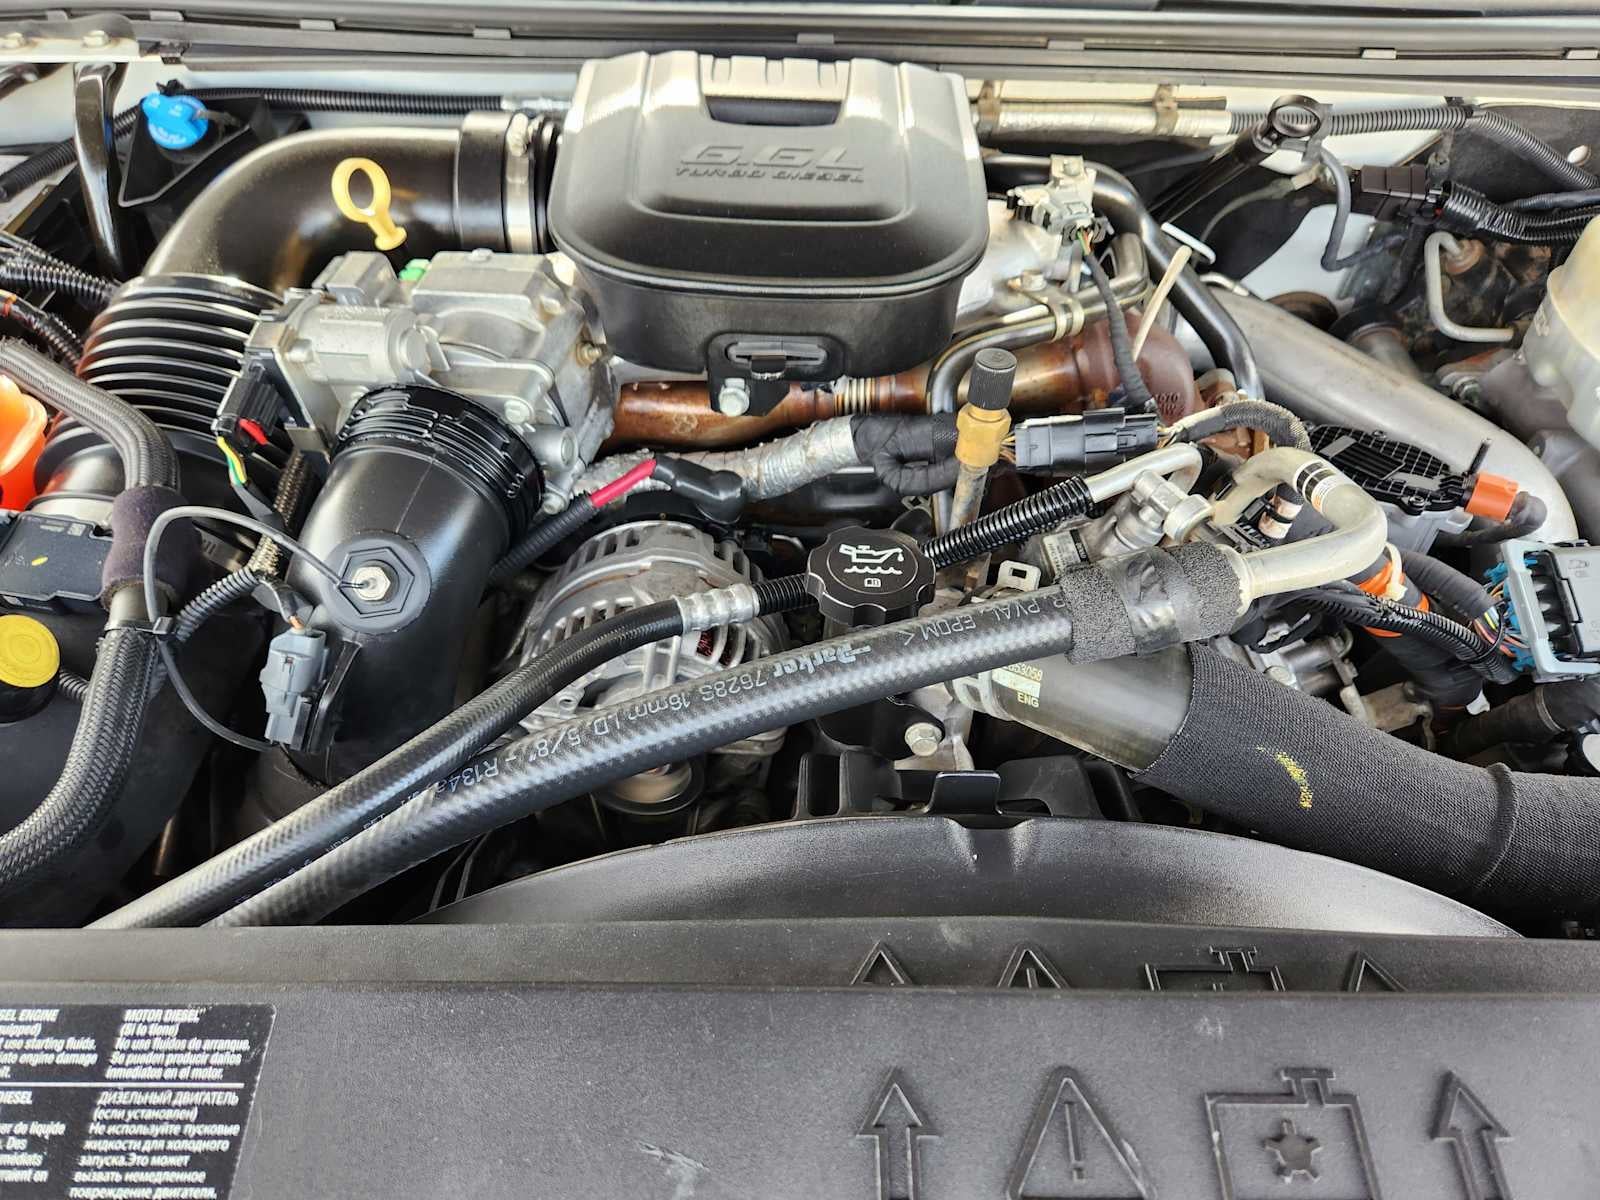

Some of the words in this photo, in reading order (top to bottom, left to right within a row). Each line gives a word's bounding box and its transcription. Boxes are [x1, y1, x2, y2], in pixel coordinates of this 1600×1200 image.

[678, 144, 865, 171] 6.6L
[674, 166, 766, 179] TURBO
[770, 169, 866, 184] DIESEL
[771, 643, 858, 678] Parker
[699, 669, 767, 702] 7628S
[1017, 691, 1040, 708] ENG
[18, 1008, 60, 1022] ENGINE
[123, 1008, 163, 1023] MOTOR
[163, 1008, 200, 1024] DIESEL
[3, 1039, 24, 1050] use
[24, 1036, 65, 1053] starting
[115, 1037, 131, 1051] No
[131, 1039, 152, 1051] use
[151, 1037, 187, 1052] fluidos
[187, 1037, 202, 1051] de
[18, 1051, 55, 1067] engine
[55, 1051, 98, 1067] damage
[110, 1050, 126, 1065] Se
[125, 1051, 165, 1067] pueden
[164, 1051, 210, 1068] producir
[208, 1051, 242, 1066] daños
[163, 1067, 178, 1080] en
[178, 1065, 191, 1080] el
[190, 1066, 224, 1080] motor.
[97, 1089, 173, 1107] ДИЗЕЛЬНЫЙ
[172, 1091, 239, 1107] ДВИГАТЕЛЬ
[93, 1106, 126, 1121] (если
[125, 1106, 198, 1122] установлен)
[13, 1121, 29, 1136] de
[29, 1121, 66, 1140] liquide
[88, 1122, 106, 1135] Не
[106, 1122, 181, 1138] используйте
[182, 1124, 241, 1138] пусковые
[6, 1136, 28, 1151] Des
[83, 1140, 142, 1153] жидкости
[141, 1140, 166, 1153] для
[166, 1140, 230, 1153] холодного
[150, 1155, 191, 1168] может
[73, 1170, 123, 1183] вызвать
[124, 1171, 207, 1184] немедленное
[69, 1186, 153, 1200] повреждение
